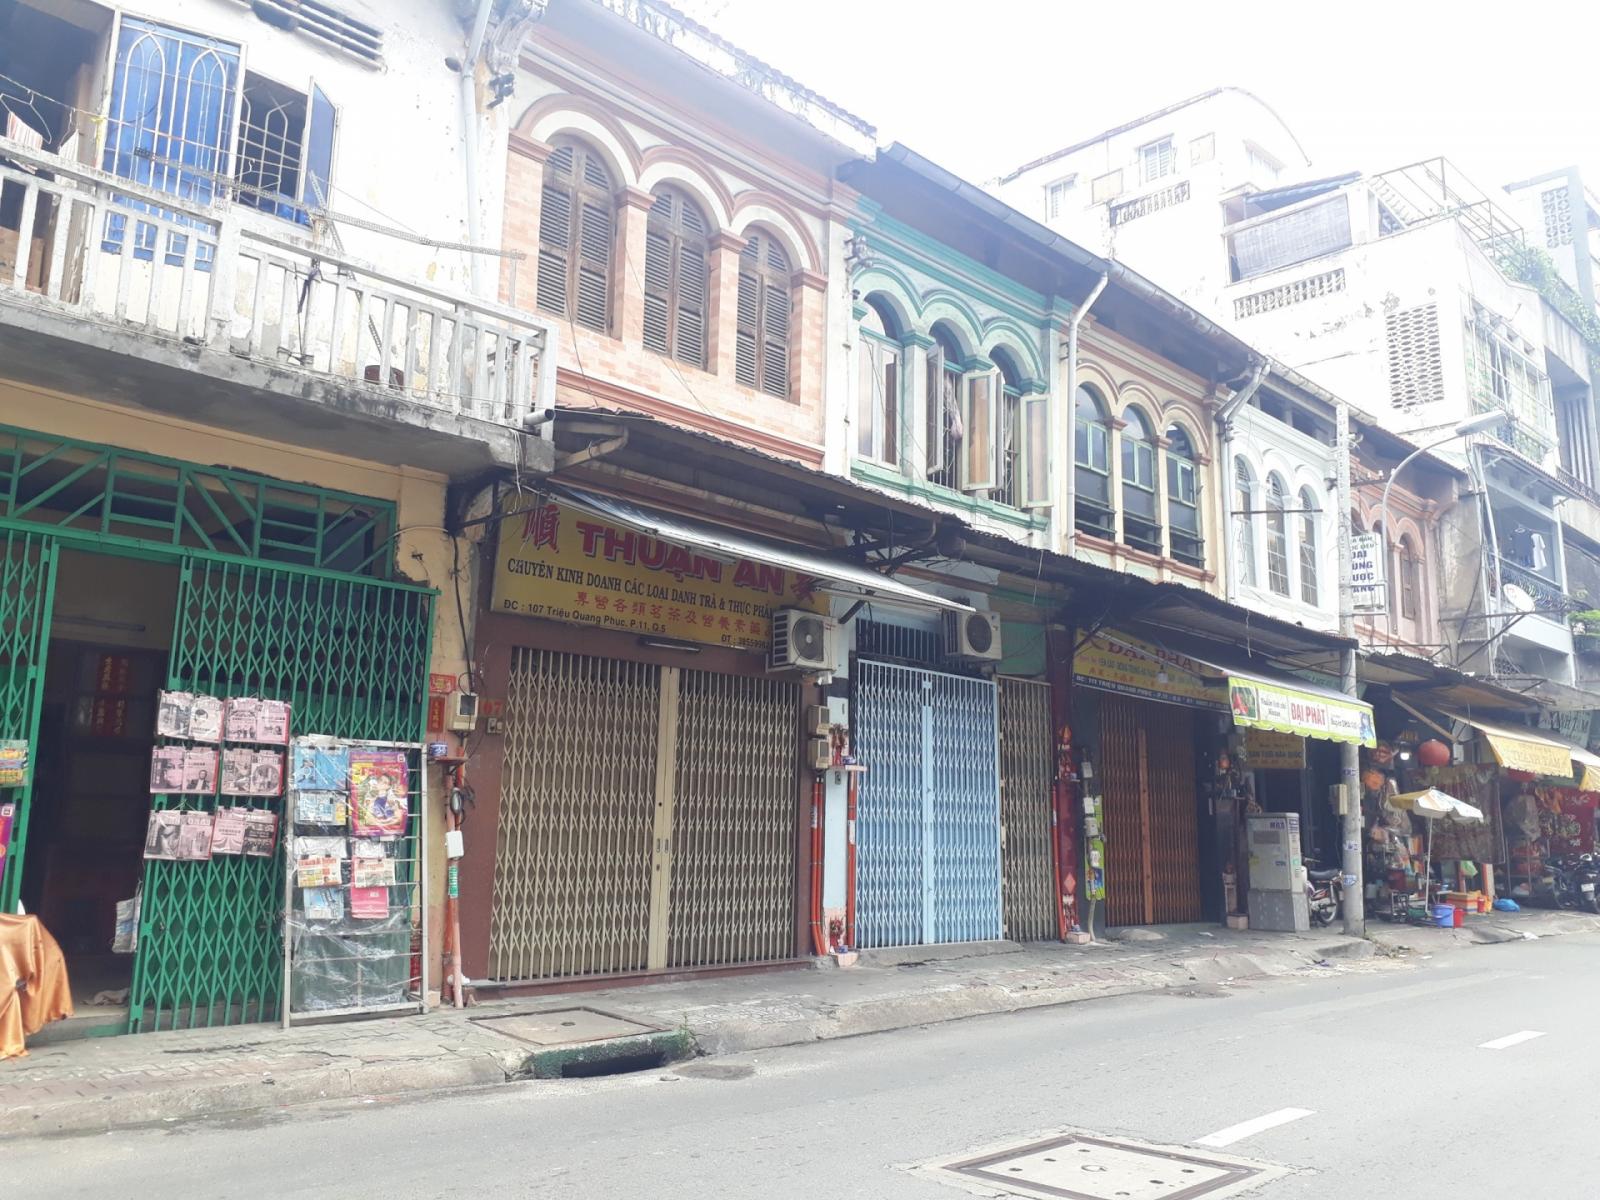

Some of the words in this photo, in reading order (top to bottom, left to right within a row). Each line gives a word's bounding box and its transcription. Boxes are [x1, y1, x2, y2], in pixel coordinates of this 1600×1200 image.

[507, 558, 554, 579] CHUYÊN
[556, 567, 584, 585] KINH
[586, 572, 622, 592] DOANH
[624, 578, 645, 596] CÁC
[671, 588, 696, 606] DANH
[719, 597, 726, 611] &
[733, 559, 785, 596] AN
[504, 599, 518, 610] ĐC
[528, 603, 544, 613] 107
[547, 606, 570, 619] Triệu
[572, 610, 602, 625] Quang
[1306, 704, 1326, 726] PHÁT
